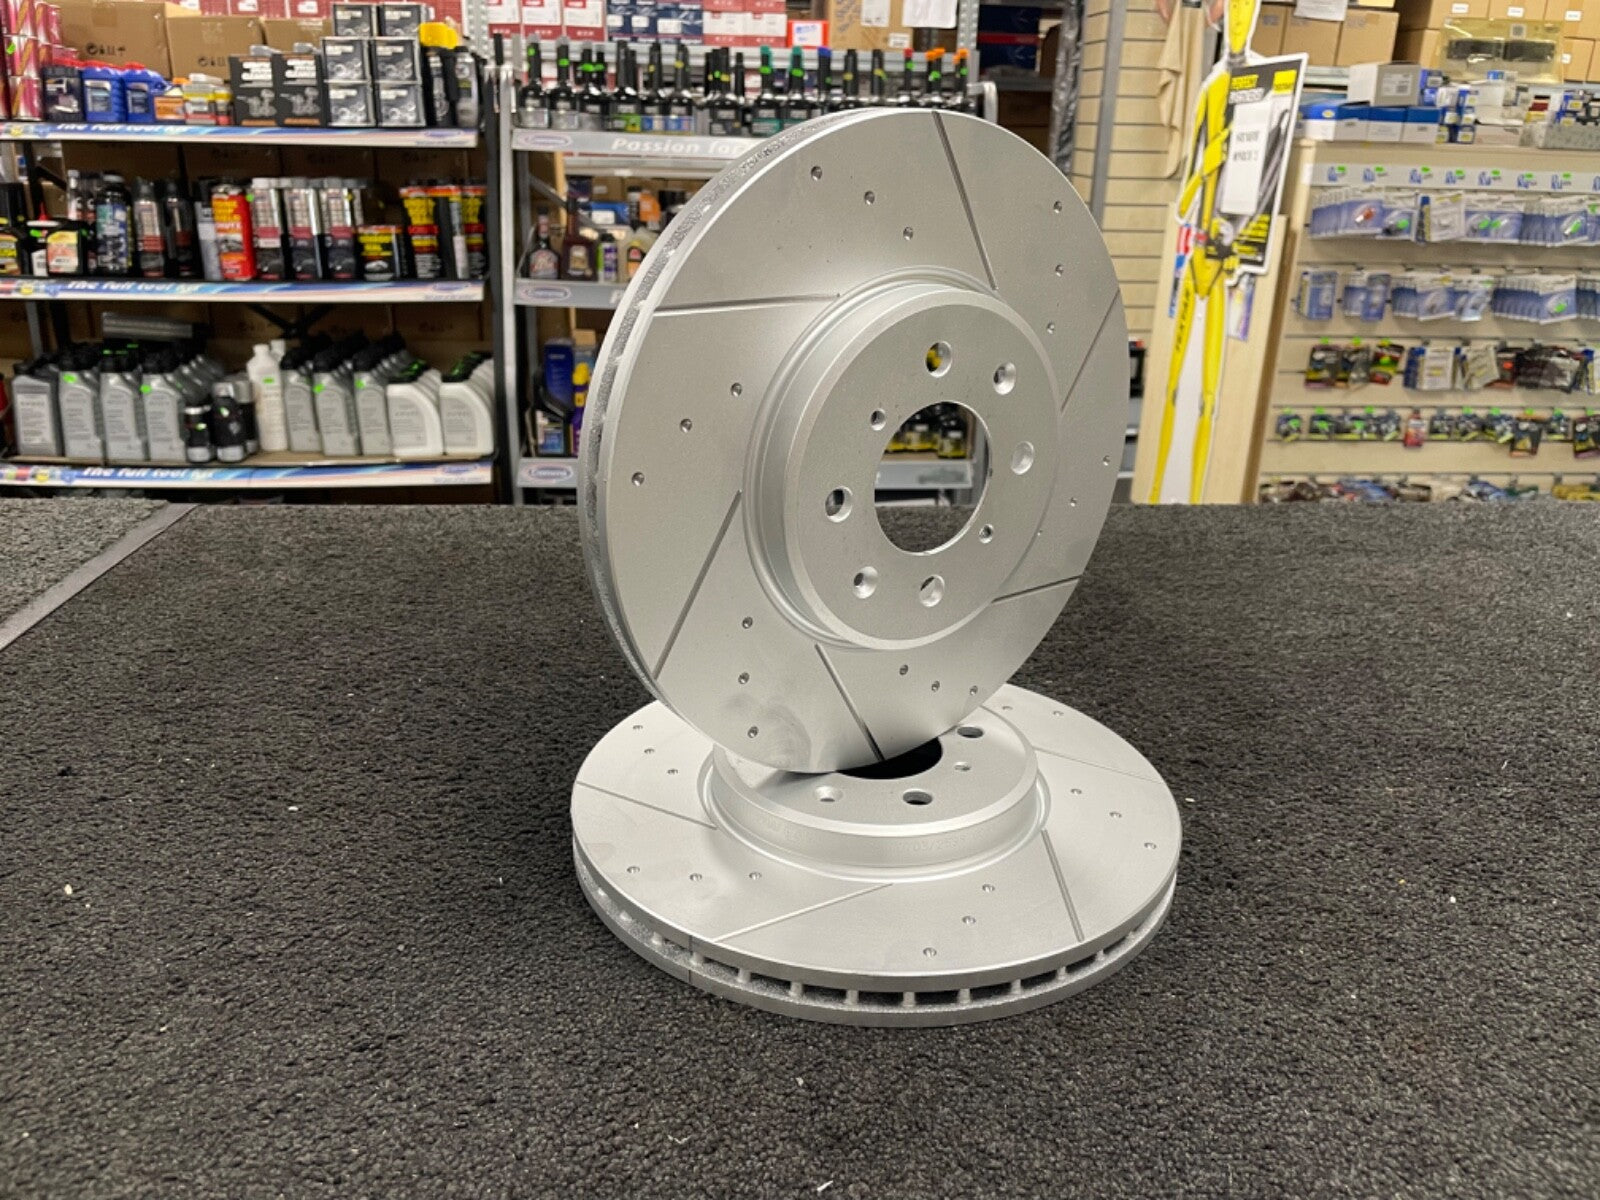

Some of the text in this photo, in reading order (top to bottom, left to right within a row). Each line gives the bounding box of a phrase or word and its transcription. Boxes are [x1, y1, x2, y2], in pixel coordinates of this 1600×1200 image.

[611, 137, 700, 154] Passion
[67, 280, 99, 289] The
[102, 280, 135, 290] full
[137, 281, 175, 291] tool
[82, 466, 115, 477] The
[117, 466, 151, 477] full
[152, 467, 190, 478] tool
